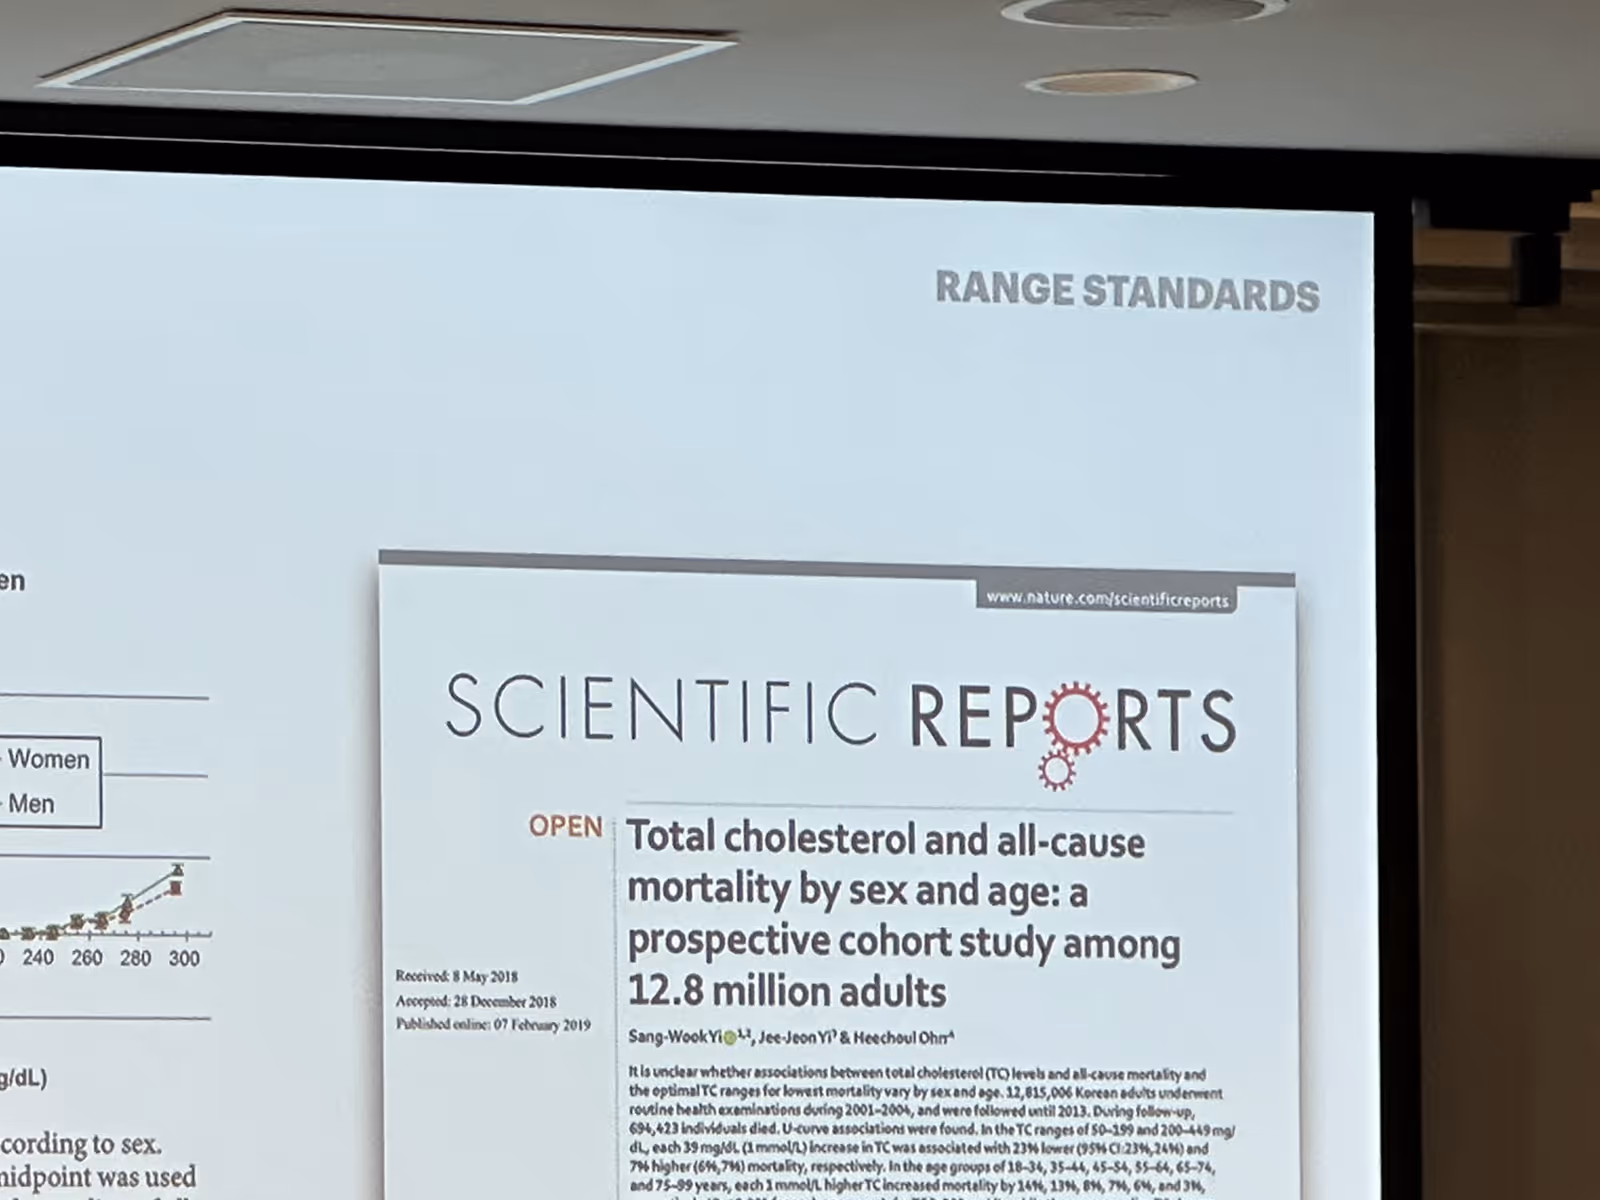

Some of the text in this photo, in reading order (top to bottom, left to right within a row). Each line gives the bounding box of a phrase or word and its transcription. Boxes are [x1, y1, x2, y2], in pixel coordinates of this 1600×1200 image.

[937, 269, 1320, 314] RANGE STANDARDS
[986, 590, 1231, 610] www.nature.com/scientificreports
[447, 672, 1236, 761] SCIENTIFIC REPORTS
[8, 748, 89, 770] Women
[9, 793, 54, 814] Men
[530, 813, 602, 838] OPEN
[626, 816, 1145, 859] Total cholesterol and all-cause
[629, 868, 1087, 917] mortality by sex and age: a
[23, 948, 54, 966] 240
[72, 948, 103, 966] 260
[121, 949, 151, 968] 280
[169, 949, 200, 968] 300
[629, 920, 1180, 970] prospective cohort study among
[629, 972, 946, 1008] 12.8 million adults
[93, 1134, 115, 1155] to
[121, 1137, 162, 1155] sex.
[97, 1170, 139, 1188] was
[145, 1162, 196, 1188] used
